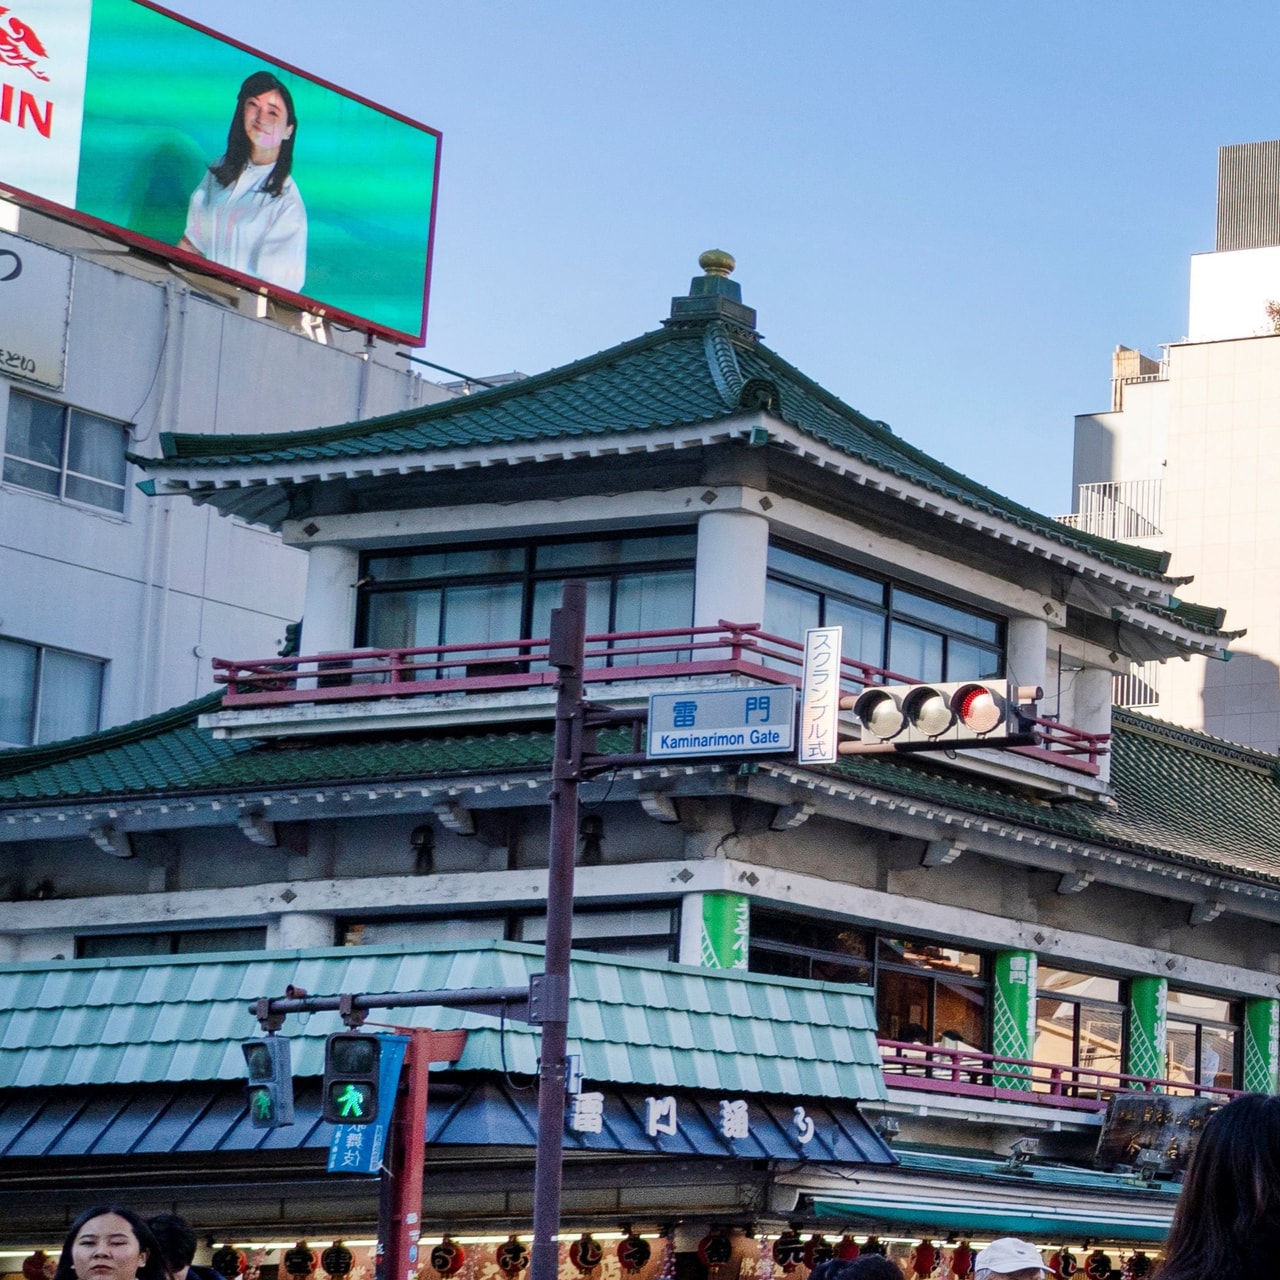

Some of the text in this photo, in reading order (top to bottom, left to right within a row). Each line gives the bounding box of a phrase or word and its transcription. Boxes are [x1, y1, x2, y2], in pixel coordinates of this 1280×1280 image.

[673, 696, 770, 727] 雷門
[661, 729, 780, 749] Kaminarimon Gate
